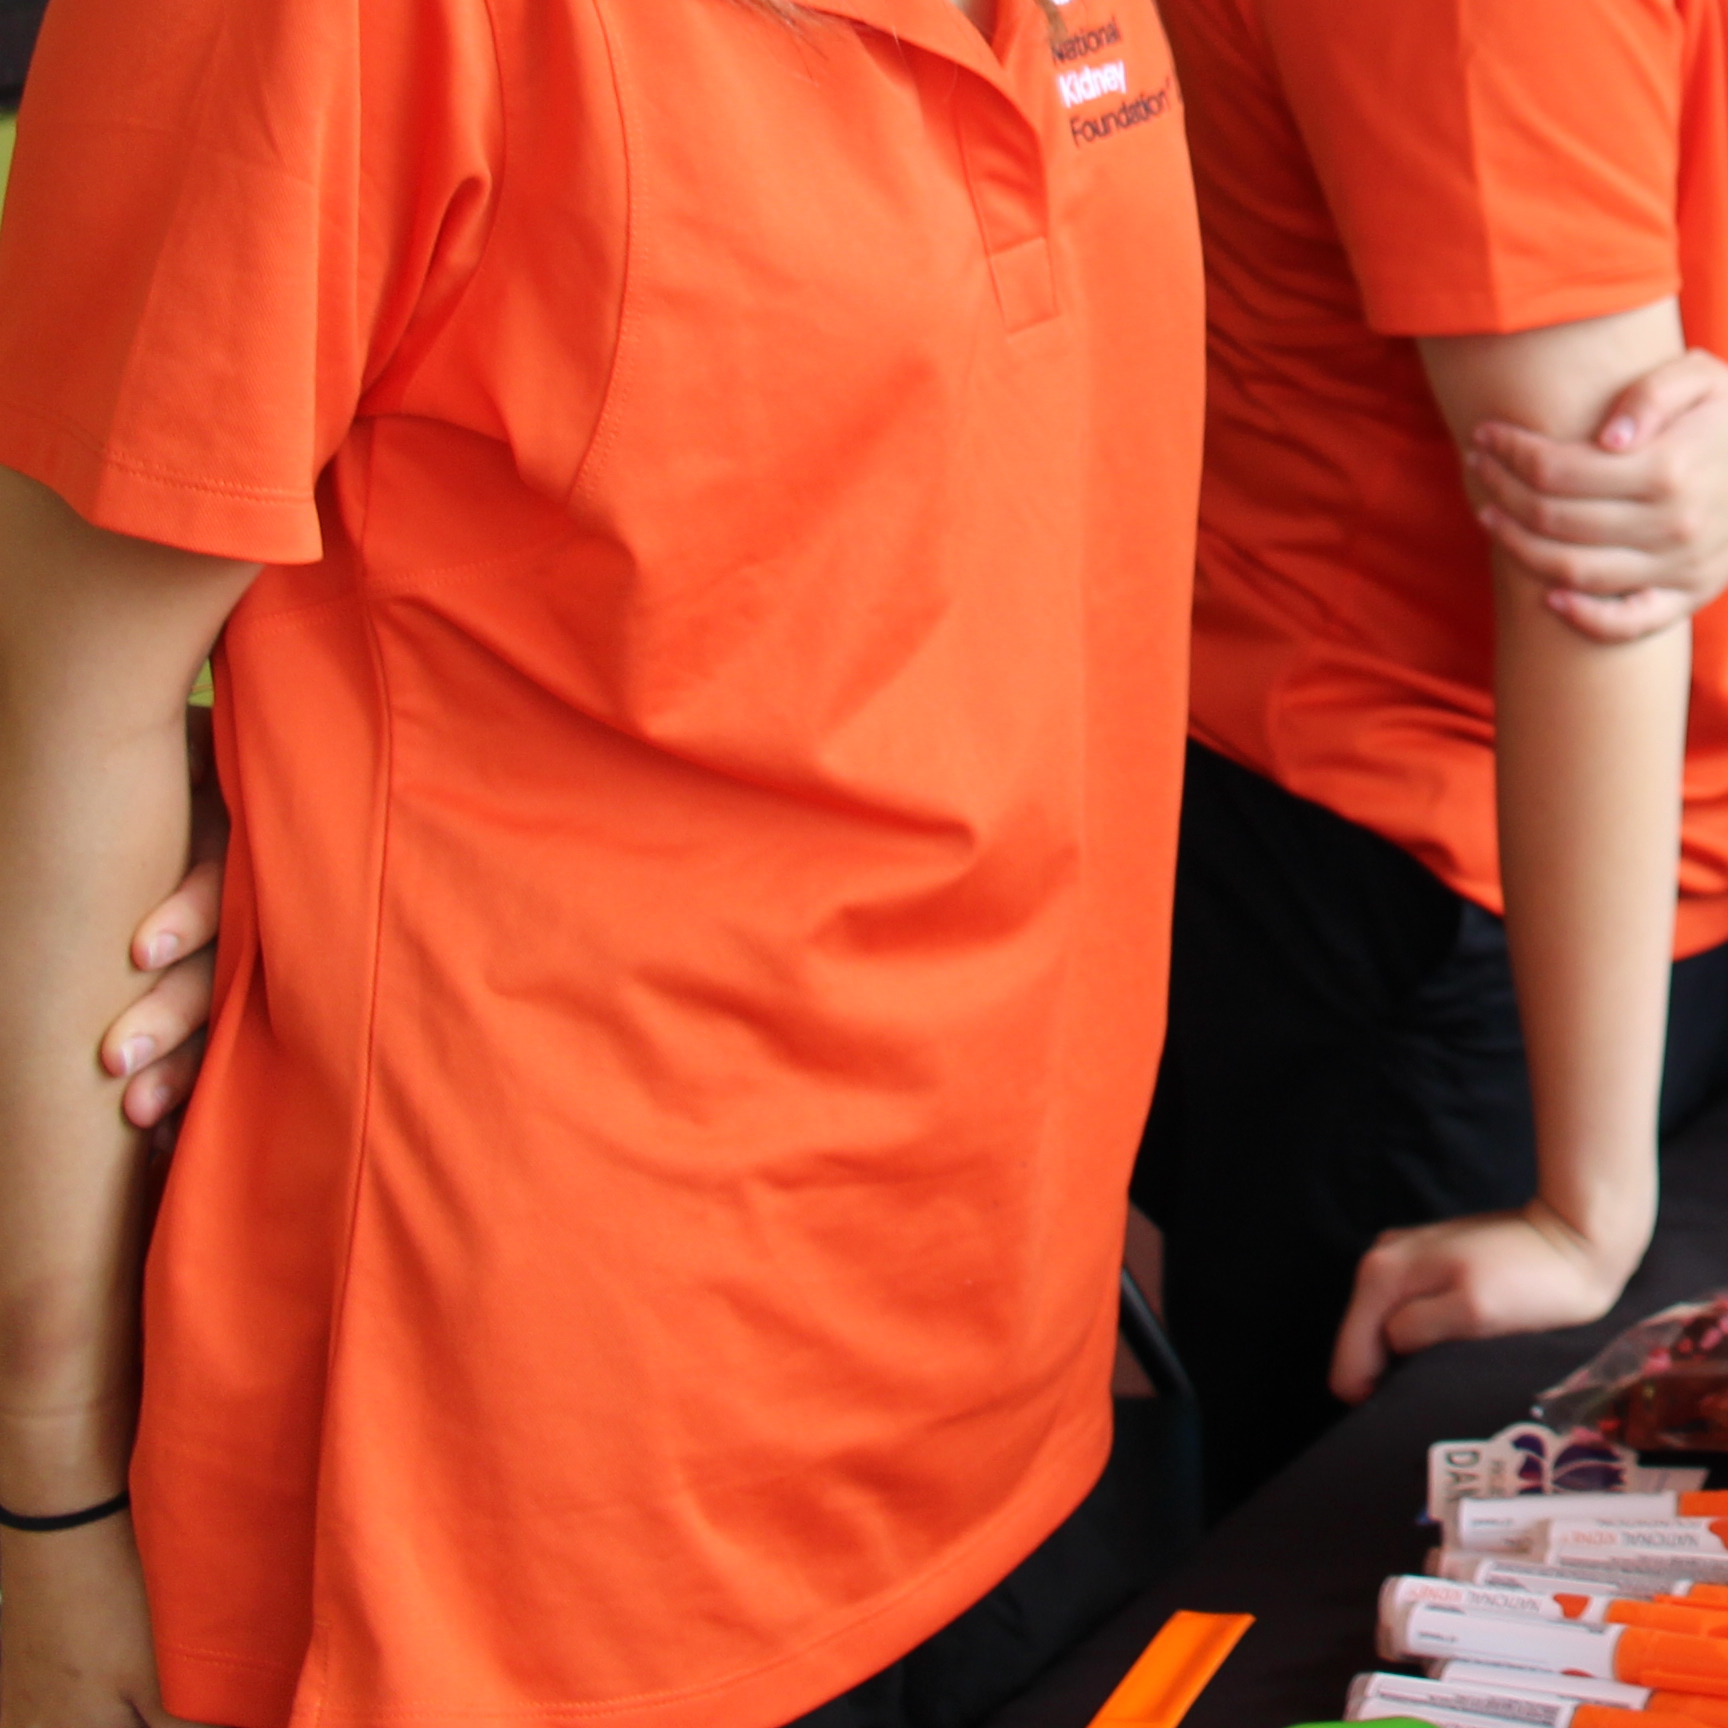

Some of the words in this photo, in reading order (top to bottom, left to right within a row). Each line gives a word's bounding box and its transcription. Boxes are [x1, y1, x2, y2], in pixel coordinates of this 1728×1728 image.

[1051, 16, 1122, 67] National
[1056, 60, 1127, 108] Kidney
[1069, 84, 1171, 149] Foundation
